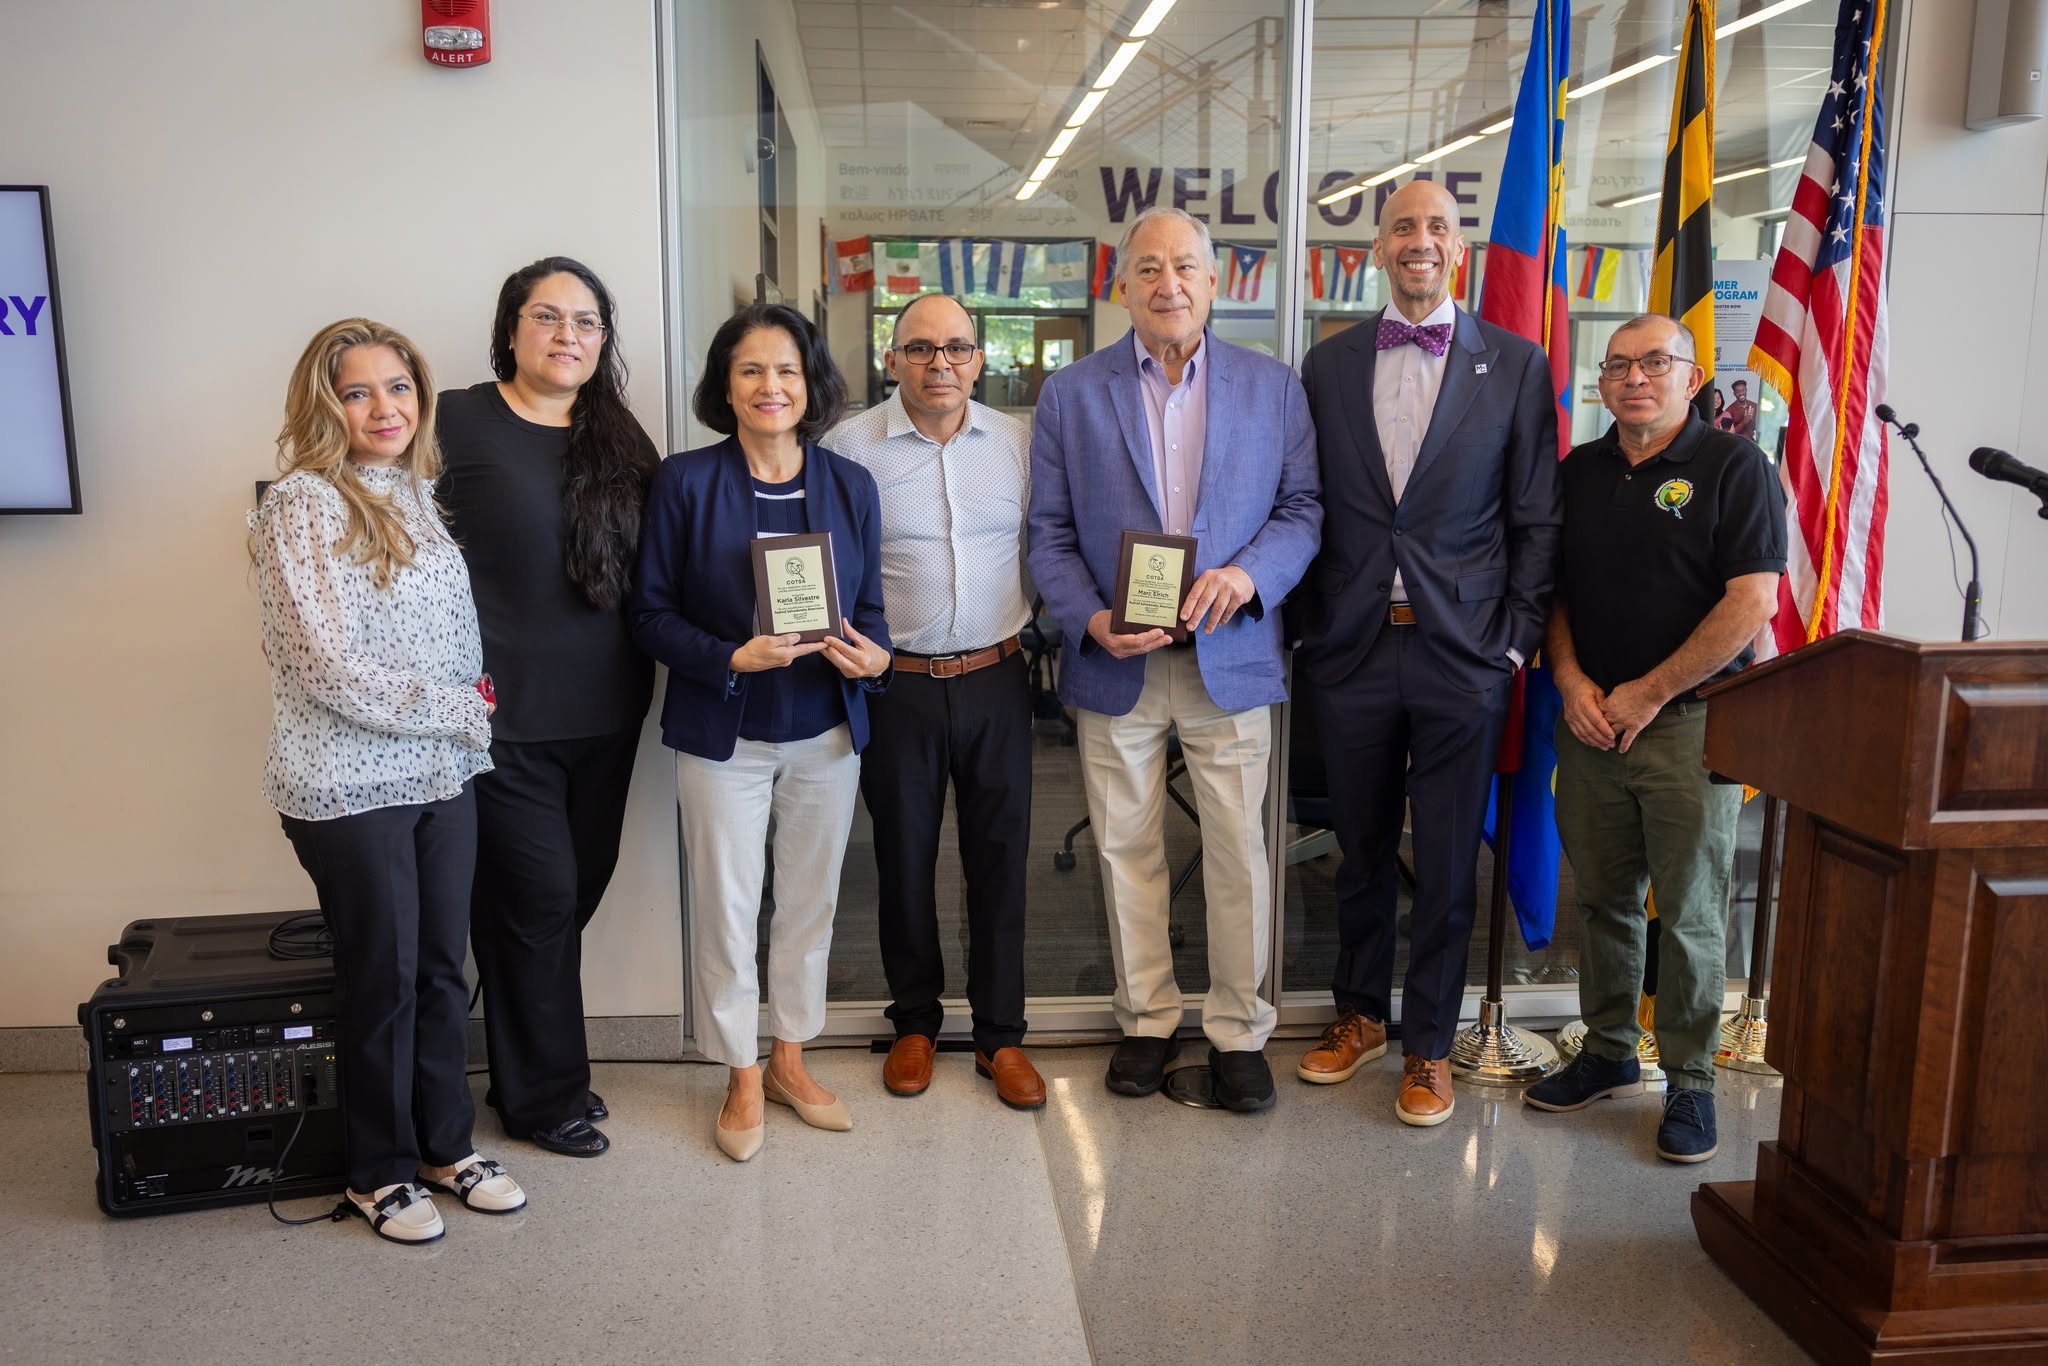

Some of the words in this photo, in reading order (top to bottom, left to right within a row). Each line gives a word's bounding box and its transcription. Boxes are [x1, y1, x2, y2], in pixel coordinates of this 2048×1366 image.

[431, 52, 474, 63] ALERT
[839, 162, 910, 176] Bem-vindo
[1713, 291, 1758, 300] OGRAM
[295, 1041, 332, 1051] ALESIS
